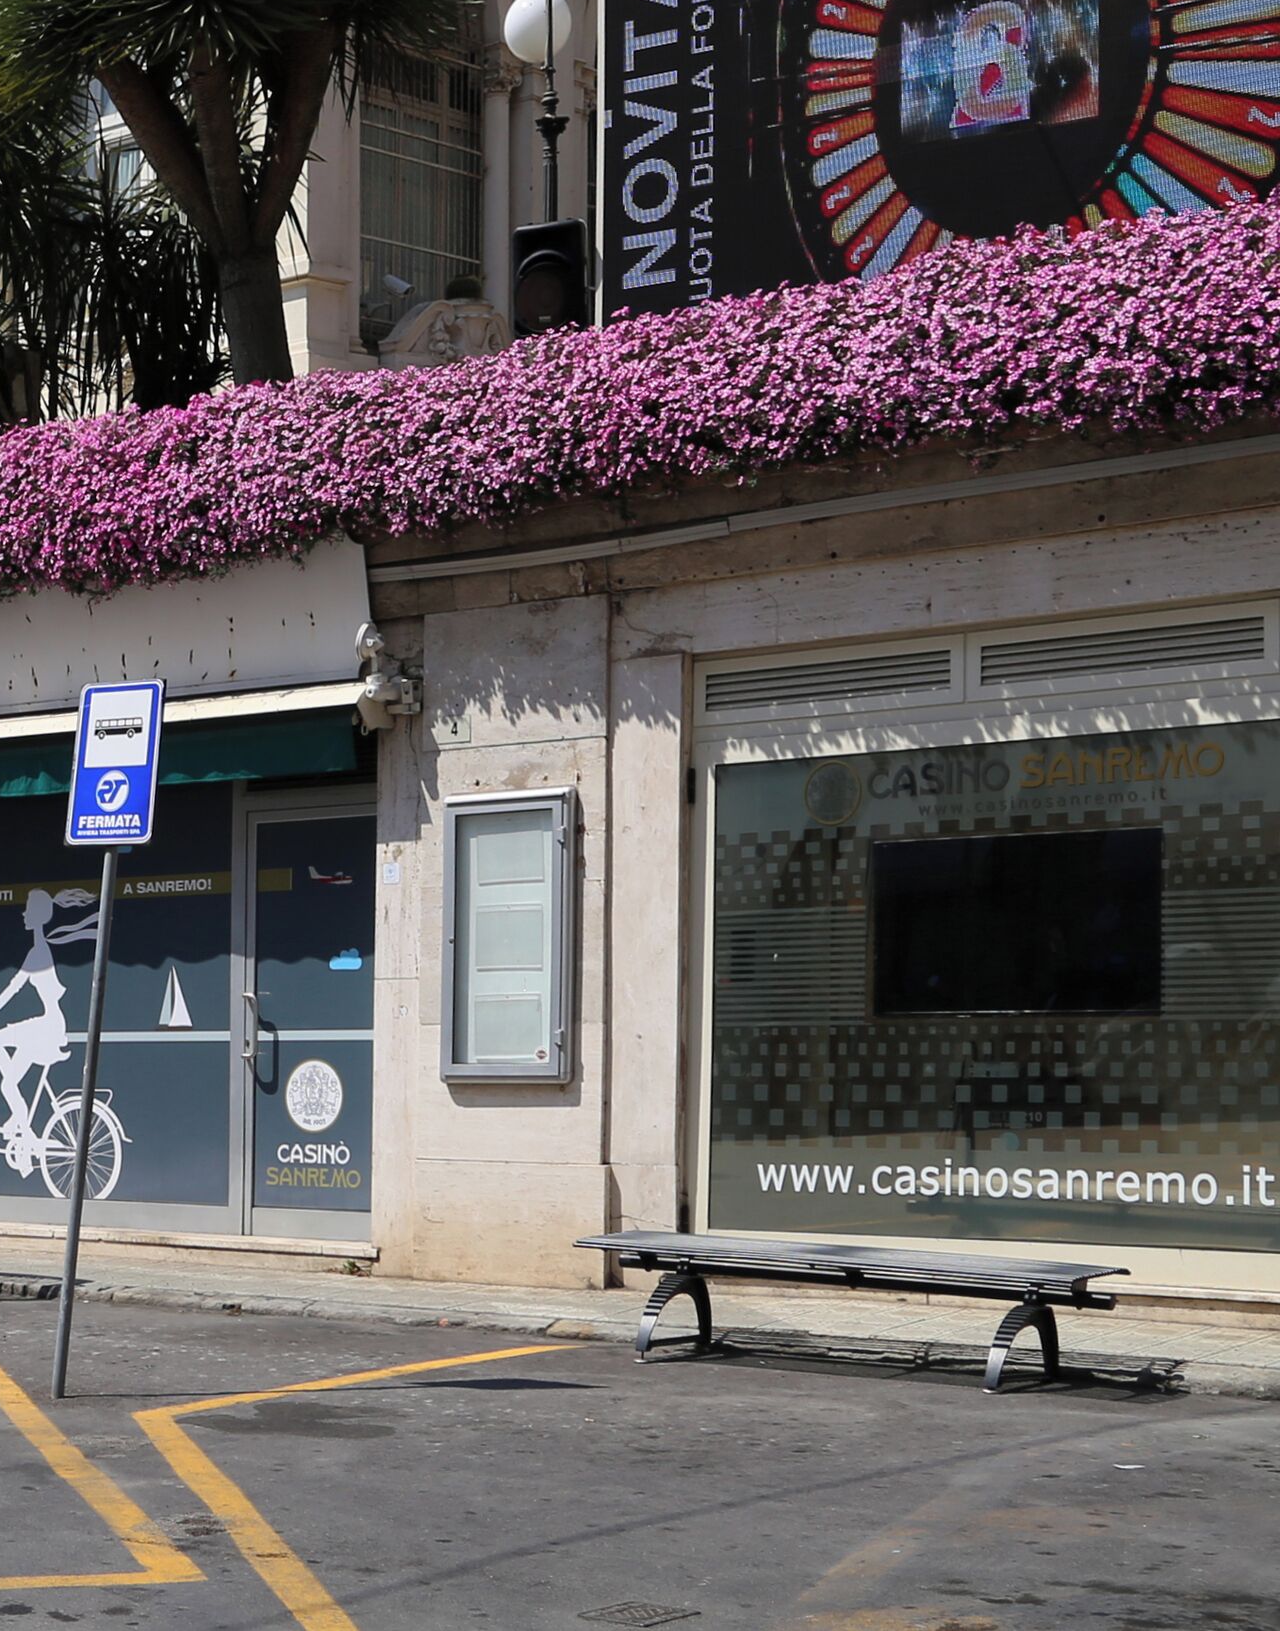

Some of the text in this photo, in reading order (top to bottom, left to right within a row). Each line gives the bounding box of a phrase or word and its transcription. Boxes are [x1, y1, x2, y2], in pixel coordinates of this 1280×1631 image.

[691, 65, 714, 187] DELLA
[689, 197, 713, 306] UOTA
[451, 721, 458, 737] 4
[866, 741, 1226, 800] CASINO SANREMO
[918, 786, 1169, 817] www.casinosanremo.it
[77, 814, 141, 829] FERMATA
[123, 883, 133, 895] A
[136, 879, 212, 894] SANREMO!
[277, 1140, 351, 1165] CASINÒ
[265, 1167, 361, 1188] SANREMO
[757, 1158, 1276, 1206] www.casinosanremo.it
